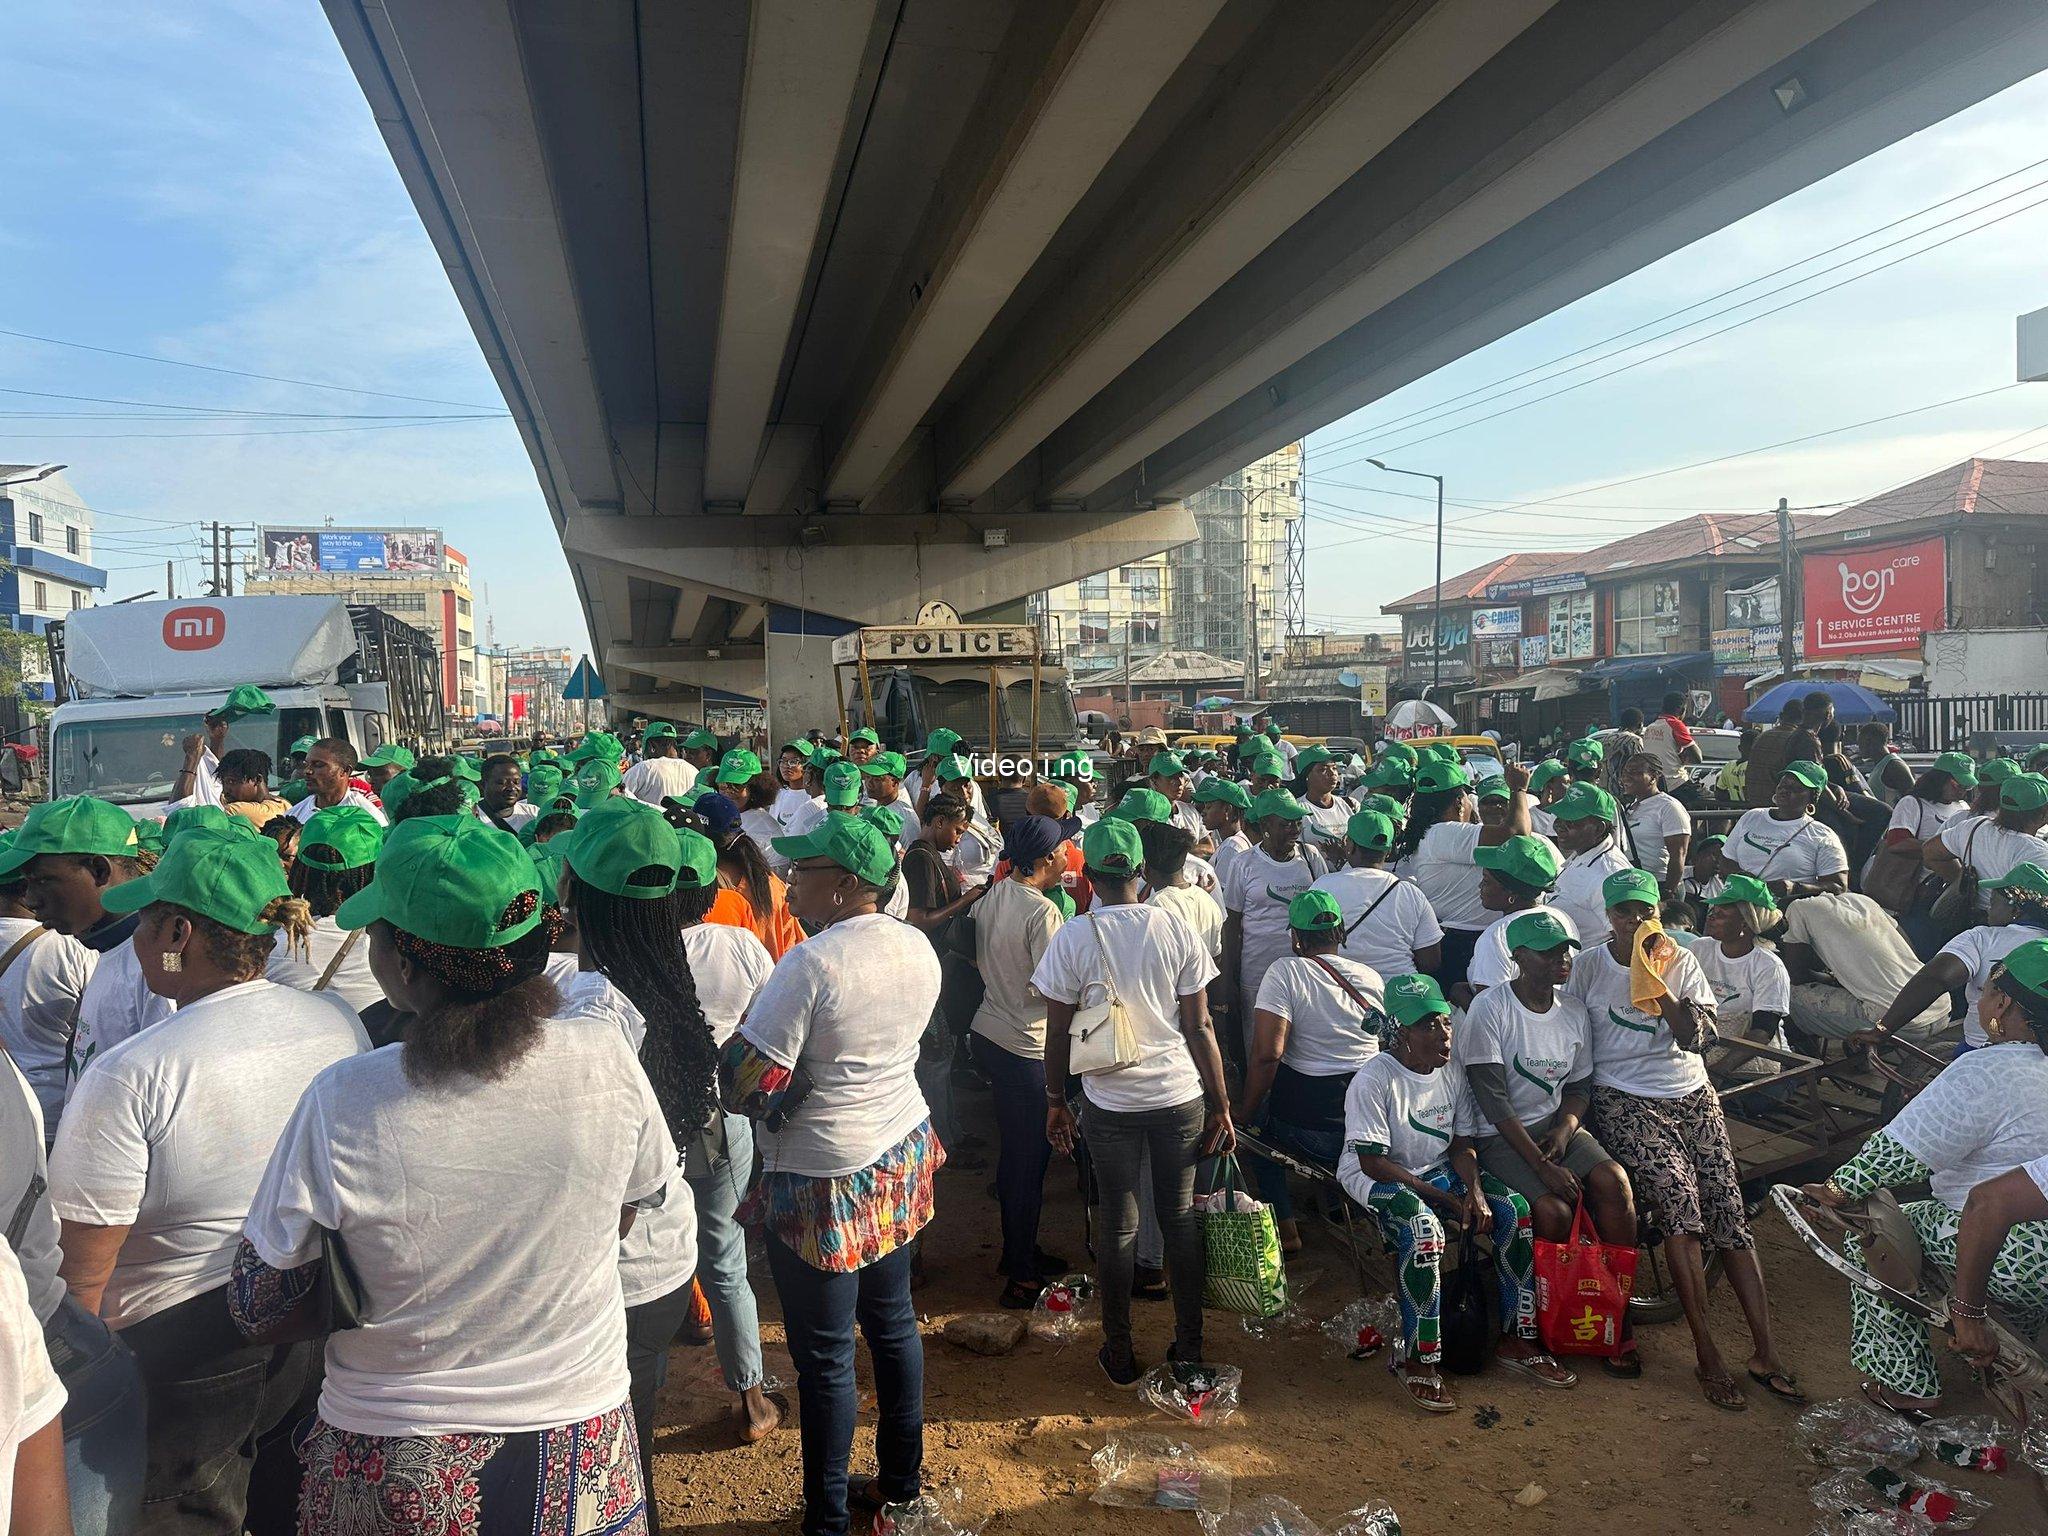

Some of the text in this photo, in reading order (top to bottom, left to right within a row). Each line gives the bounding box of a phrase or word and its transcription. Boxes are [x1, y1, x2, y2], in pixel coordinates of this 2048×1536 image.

[1892, 555, 1920, 568] care
[1838, 562, 1895, 608] bon
[1828, 612, 1920, 631] SERVICE CENTRE
[891, 632, 1013, 654] POLICE
[1712, 636, 1750, 645] GRAPHICS
[1857, 629, 1877, 638] Akran
[1570, 1305, 1603, 1340] 吉
